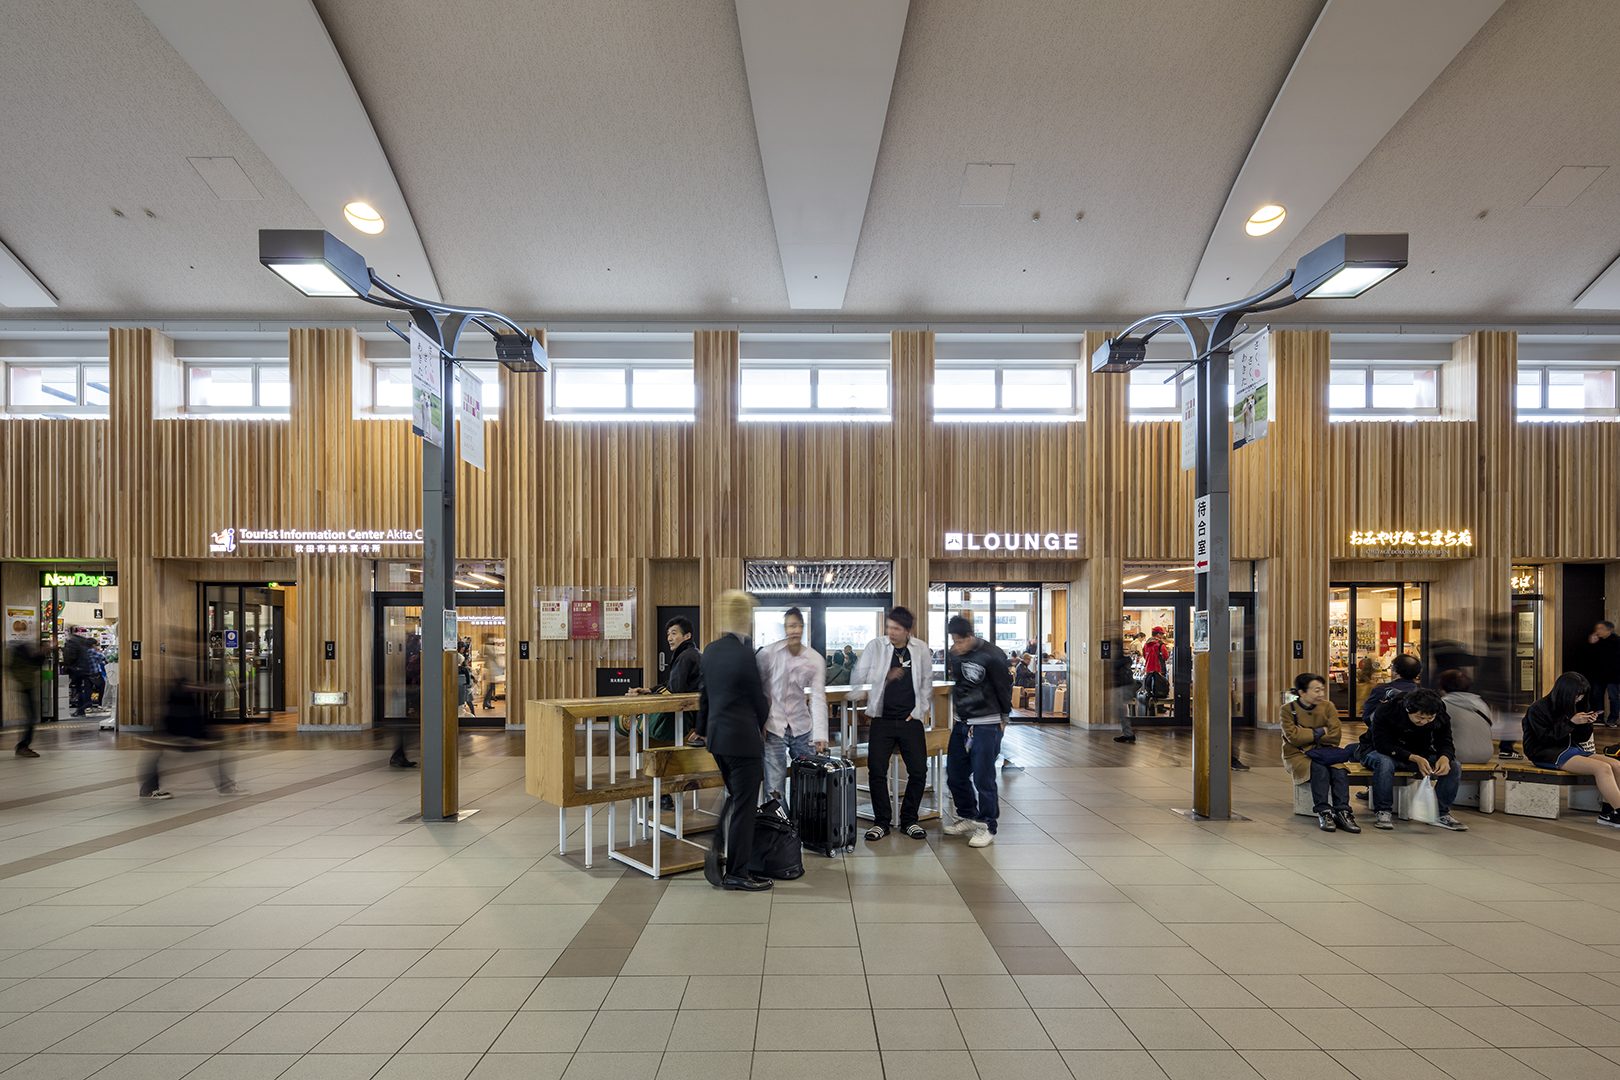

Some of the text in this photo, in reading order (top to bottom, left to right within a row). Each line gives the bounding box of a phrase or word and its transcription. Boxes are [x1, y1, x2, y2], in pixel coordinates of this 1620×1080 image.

[239, 528, 278, 540] Tourist
[280, 528, 346, 540] Information
[347, 528, 384, 540] Center
[386, 528, 413, 540] Akita
[1198, 501, 1206, 556] 待合室
[294, 544, 380, 553] 秋田市観光案内所
[967, 532, 1078, 551] LOUNGE
[44, 572, 108, 587] NewDays
